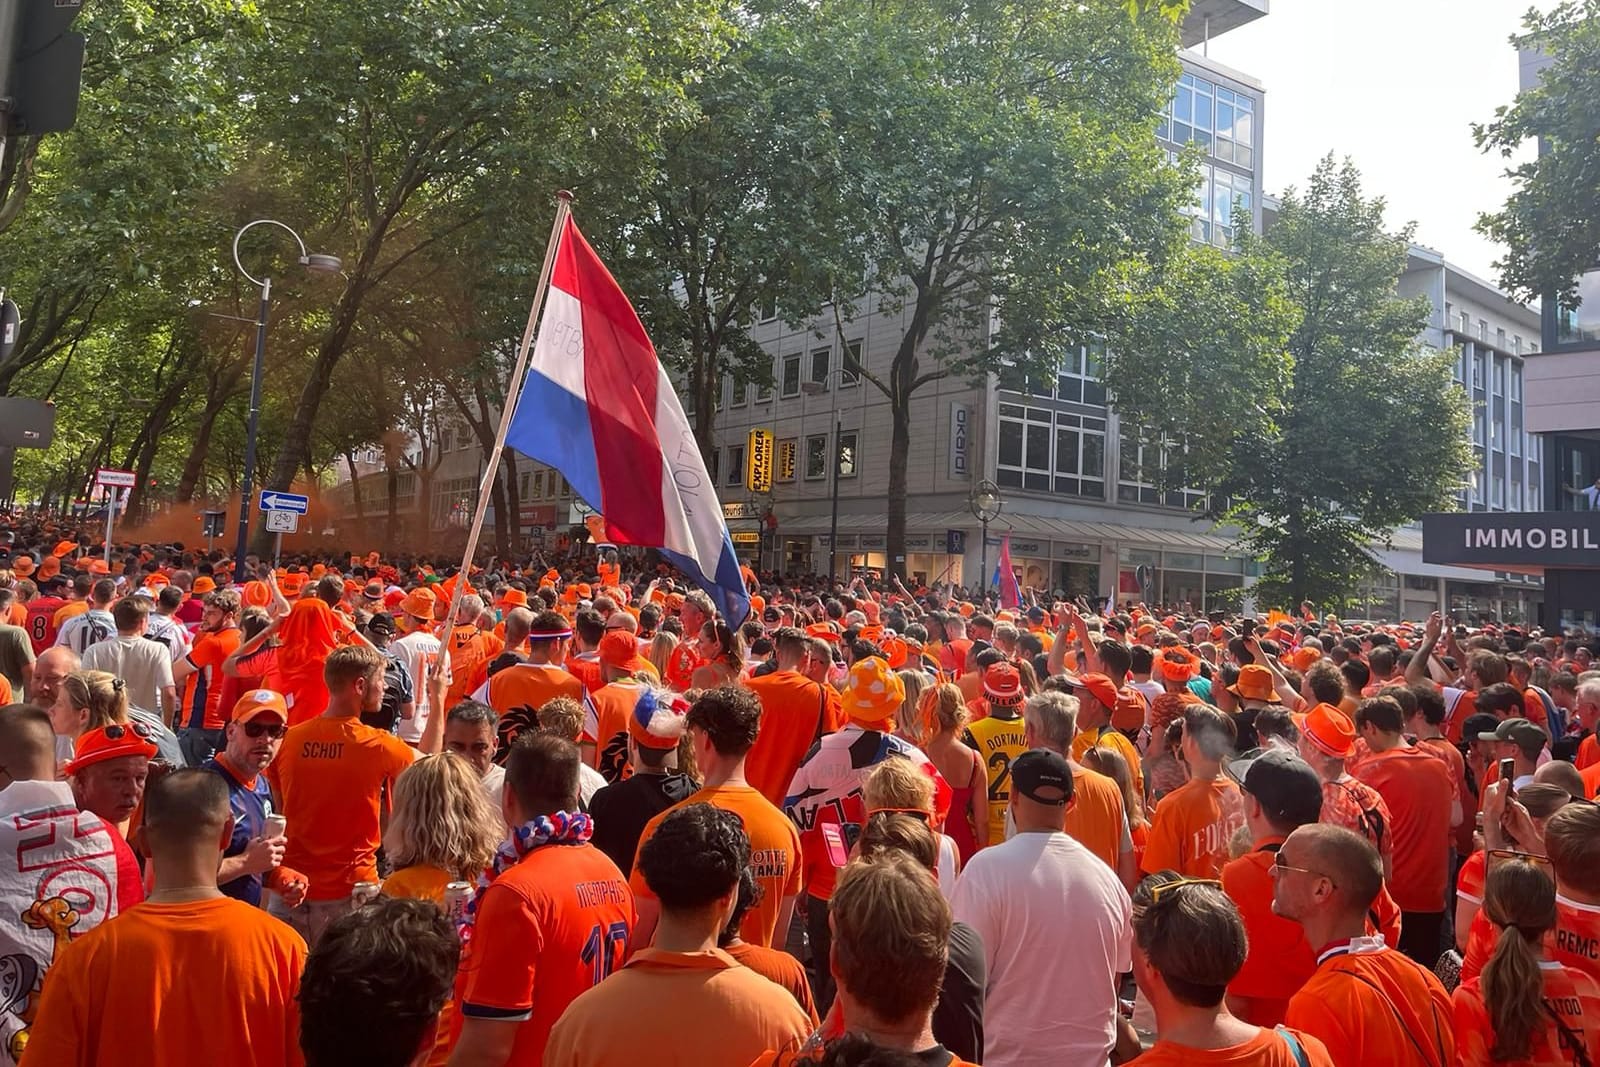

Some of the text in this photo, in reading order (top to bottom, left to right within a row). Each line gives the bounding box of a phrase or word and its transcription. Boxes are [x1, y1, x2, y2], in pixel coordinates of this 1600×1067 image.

[753, 430, 764, 490] EXPLORER
[1465, 528, 1598, 549] IMMOBIL
[33, 616, 47, 641] 8
[302, 741, 345, 760] SCHOT
[576, 880, 626, 909] MEMPHIS
[581, 921, 629, 987] 10
